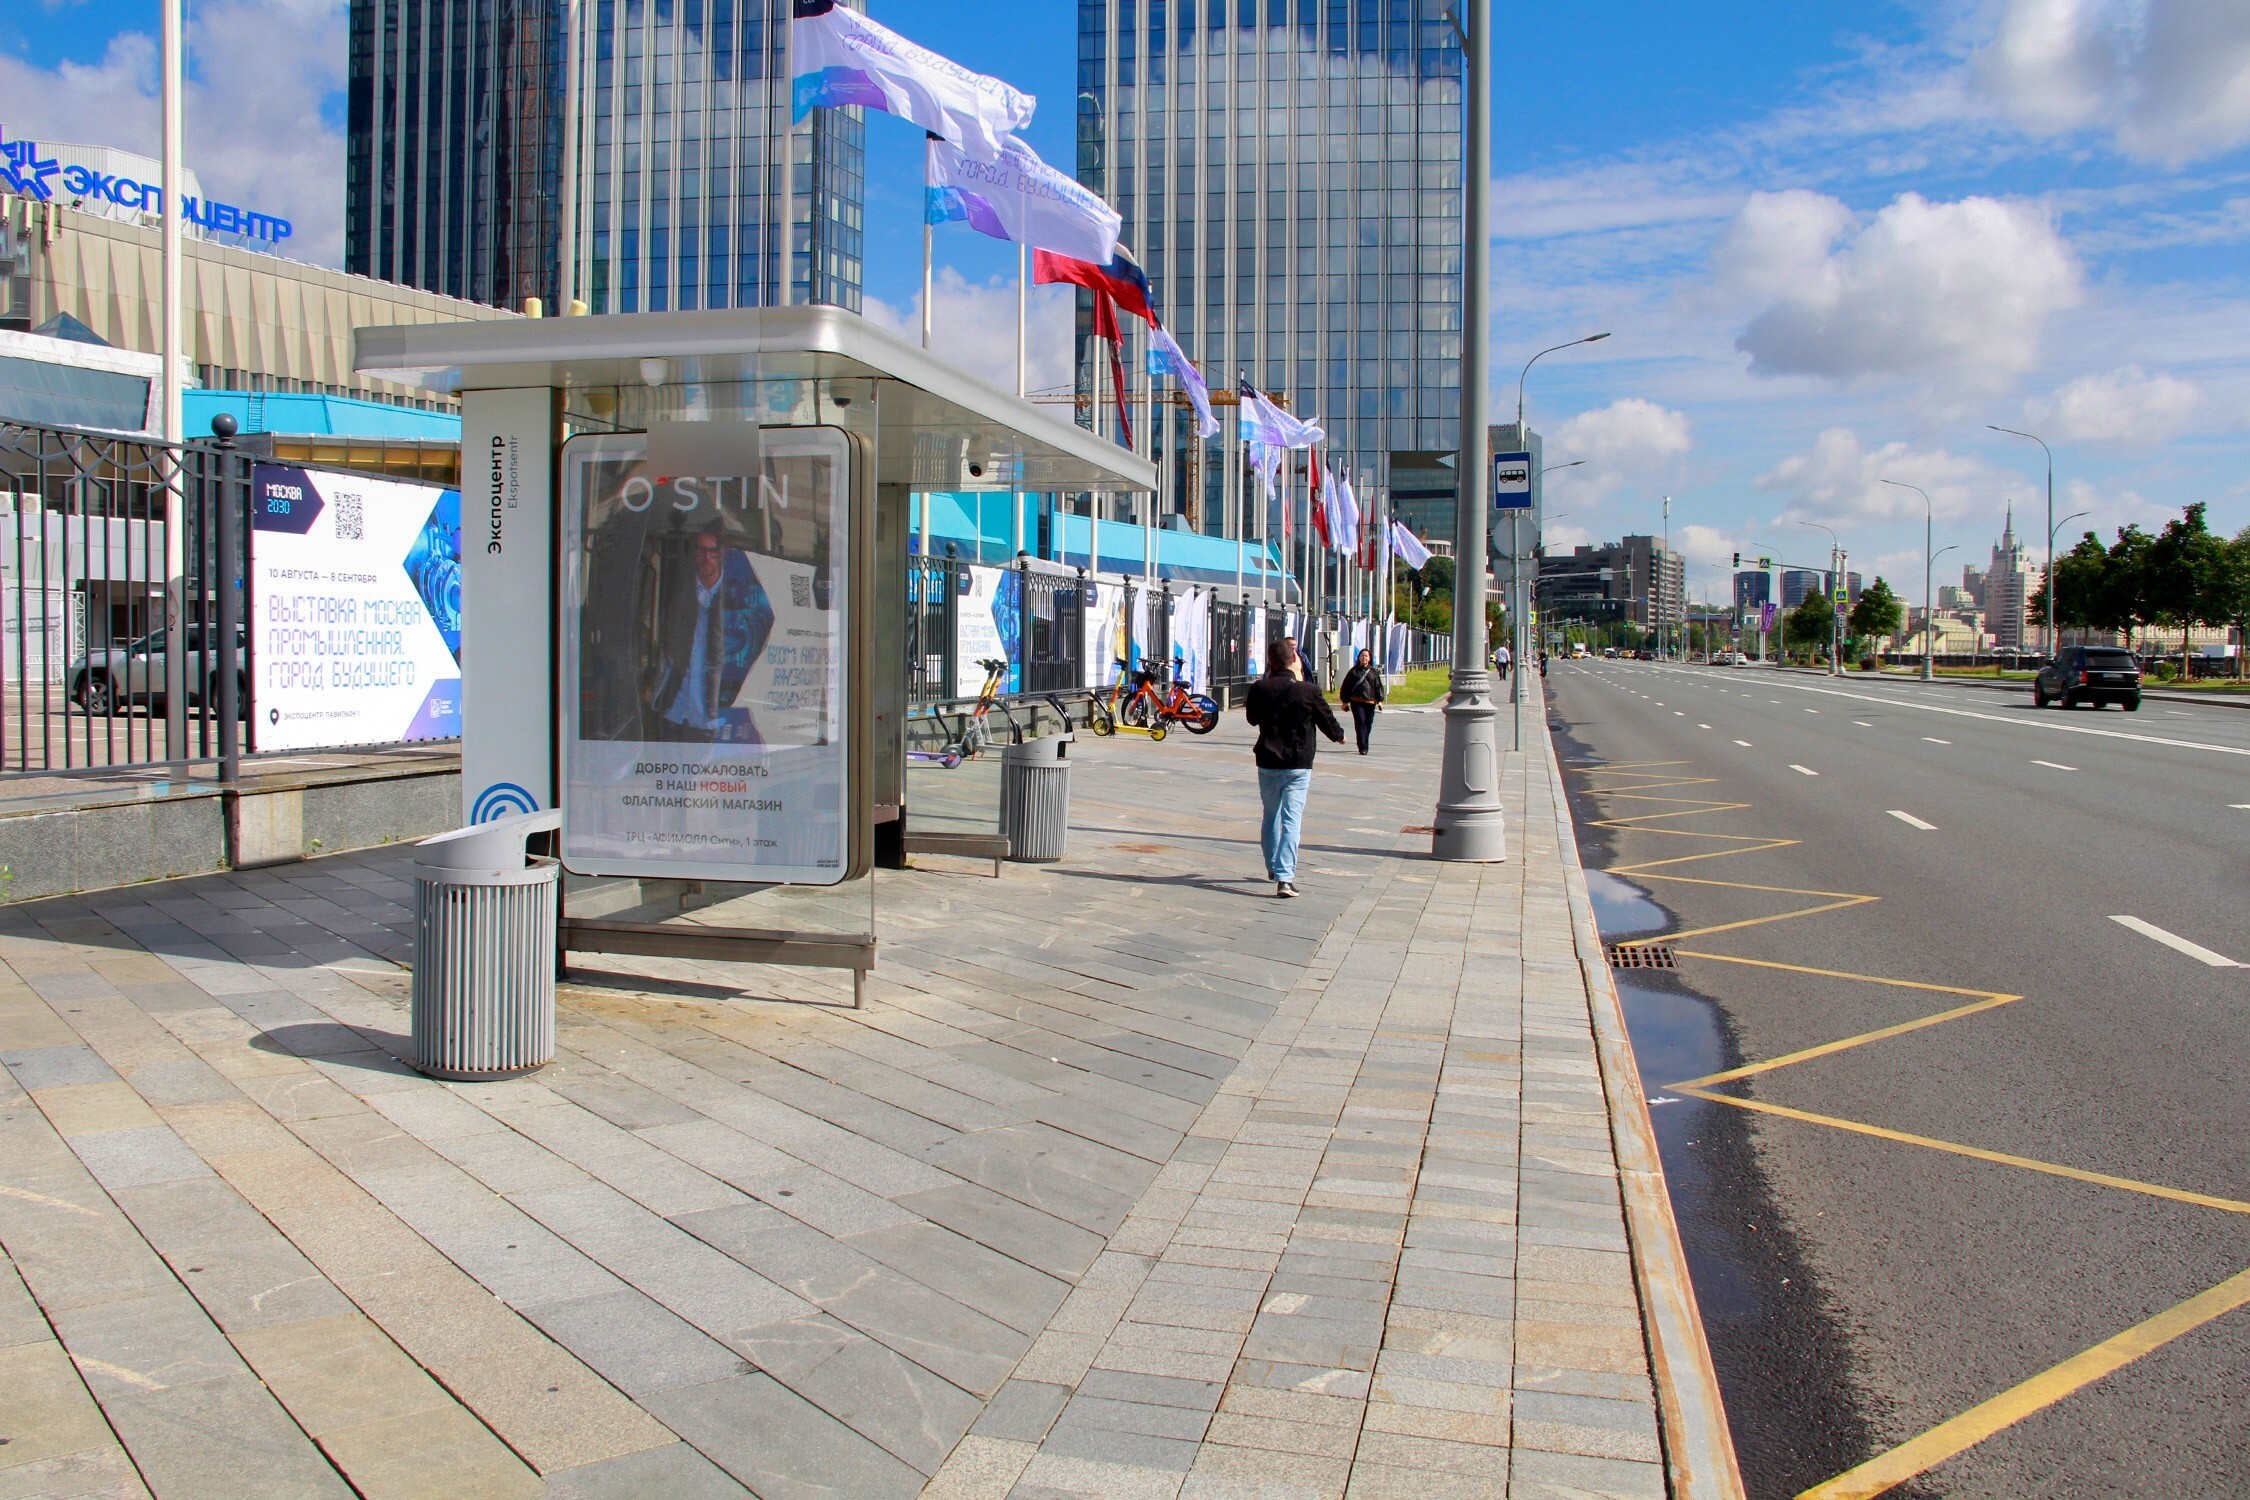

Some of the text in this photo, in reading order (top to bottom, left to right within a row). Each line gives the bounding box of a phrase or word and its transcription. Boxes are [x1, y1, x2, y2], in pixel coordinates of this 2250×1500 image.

[508, 435, 520, 509] Ekspotsentr
[266, 483, 303, 501] МОСКВА
[487, 435, 505, 554] Экспоцентр
[267, 499, 290, 515] 2030
[269, 568, 279, 578] 10
[281, 569, 320, 580] АВГУСТА
[330, 572, 336, 582] 8
[338, 573, 377, 584] СЕНТЯБРЯ
[269, 594, 421, 625] ВЫСТАВКА МОСКВА
[269, 661, 415, 691] ГОРОД БУДУЩЕГО
[635, 762, 769, 777] ДОБРО ПОЖАЛОВАТЬ
[656, 779, 747, 793] В НАШ НОВЫЙ
[622, 794, 783, 812] ФЛАГМАНСКИЙ МАГАЗИН
[626, 831, 778, 848] ТРЦ «АФИМОЛЛ Сити», 1 этаж
